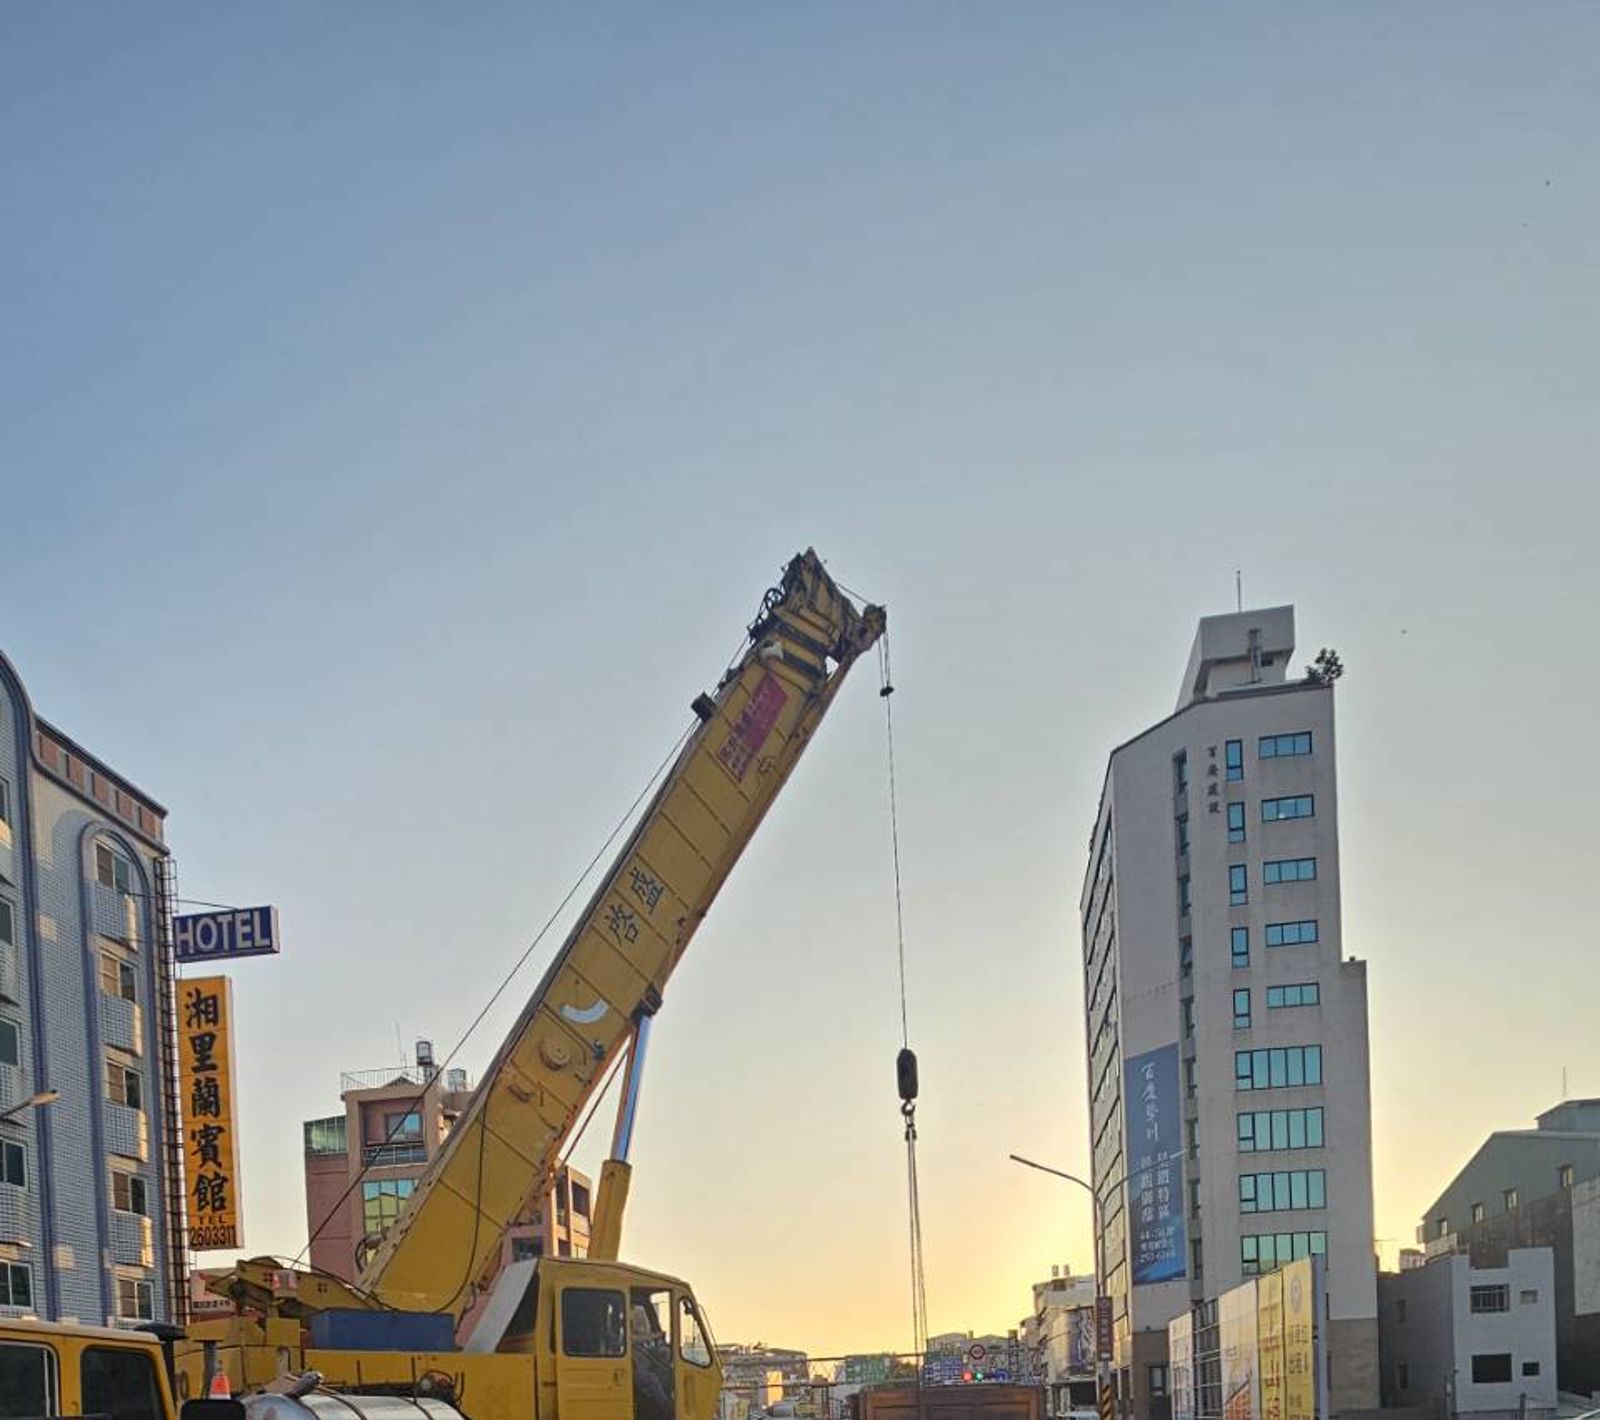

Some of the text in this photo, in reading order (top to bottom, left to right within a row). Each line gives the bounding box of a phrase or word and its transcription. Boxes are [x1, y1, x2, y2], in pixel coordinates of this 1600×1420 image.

[175, 907, 270, 956] HOTEL
[185, 989, 229, 1213] 湘里蘭賓館
[189, 1226, 237, 1248] 2603311
[199, 1215, 227, 1226] TEL
